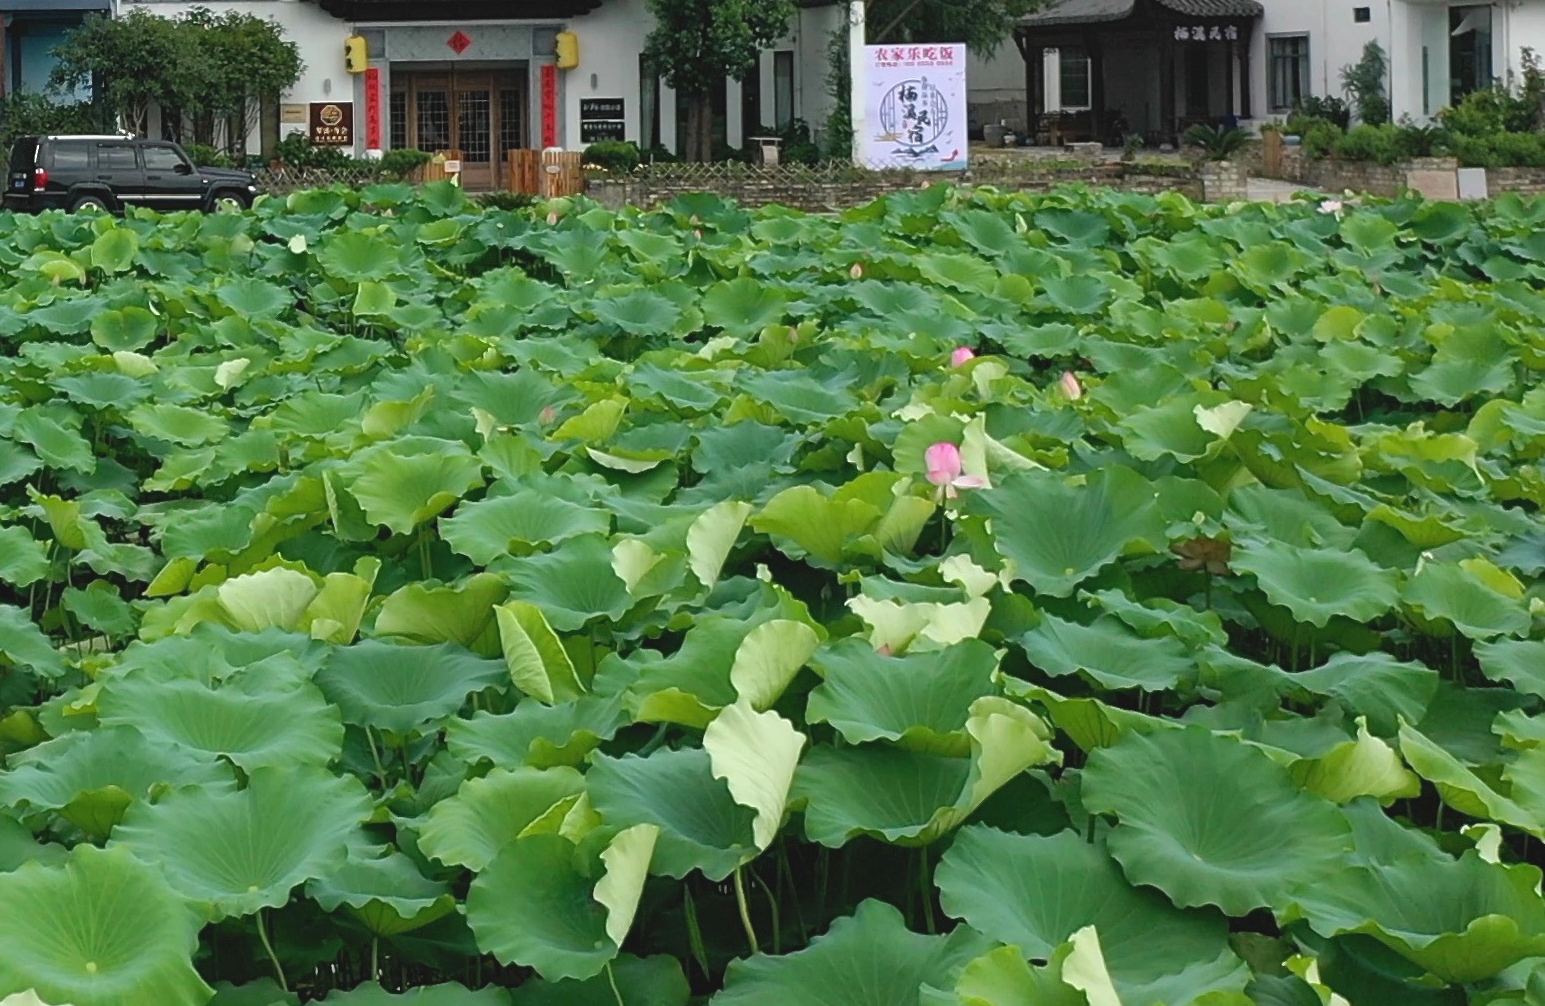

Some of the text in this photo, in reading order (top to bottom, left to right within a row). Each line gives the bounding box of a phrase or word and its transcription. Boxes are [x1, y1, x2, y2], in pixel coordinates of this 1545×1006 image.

[875, 46, 953, 61] 农家乐吃饭
